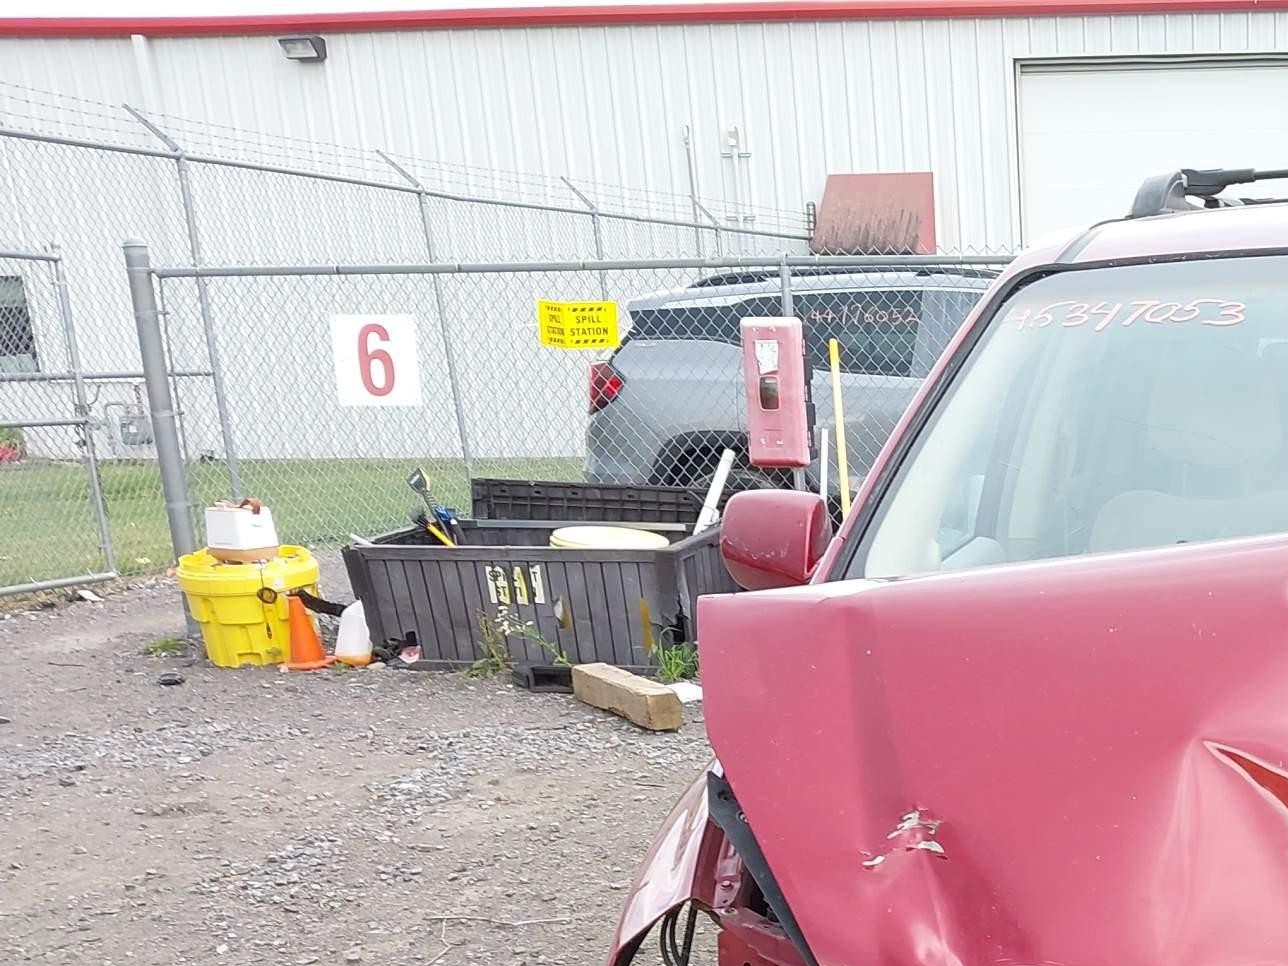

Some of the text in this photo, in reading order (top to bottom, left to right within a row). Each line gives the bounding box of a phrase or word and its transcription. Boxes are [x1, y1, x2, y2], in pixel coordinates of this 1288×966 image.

[575, 315, 602, 324] SPILL
[570, 327, 609, 336] STATION
[357, 323, 395, 397] 6
